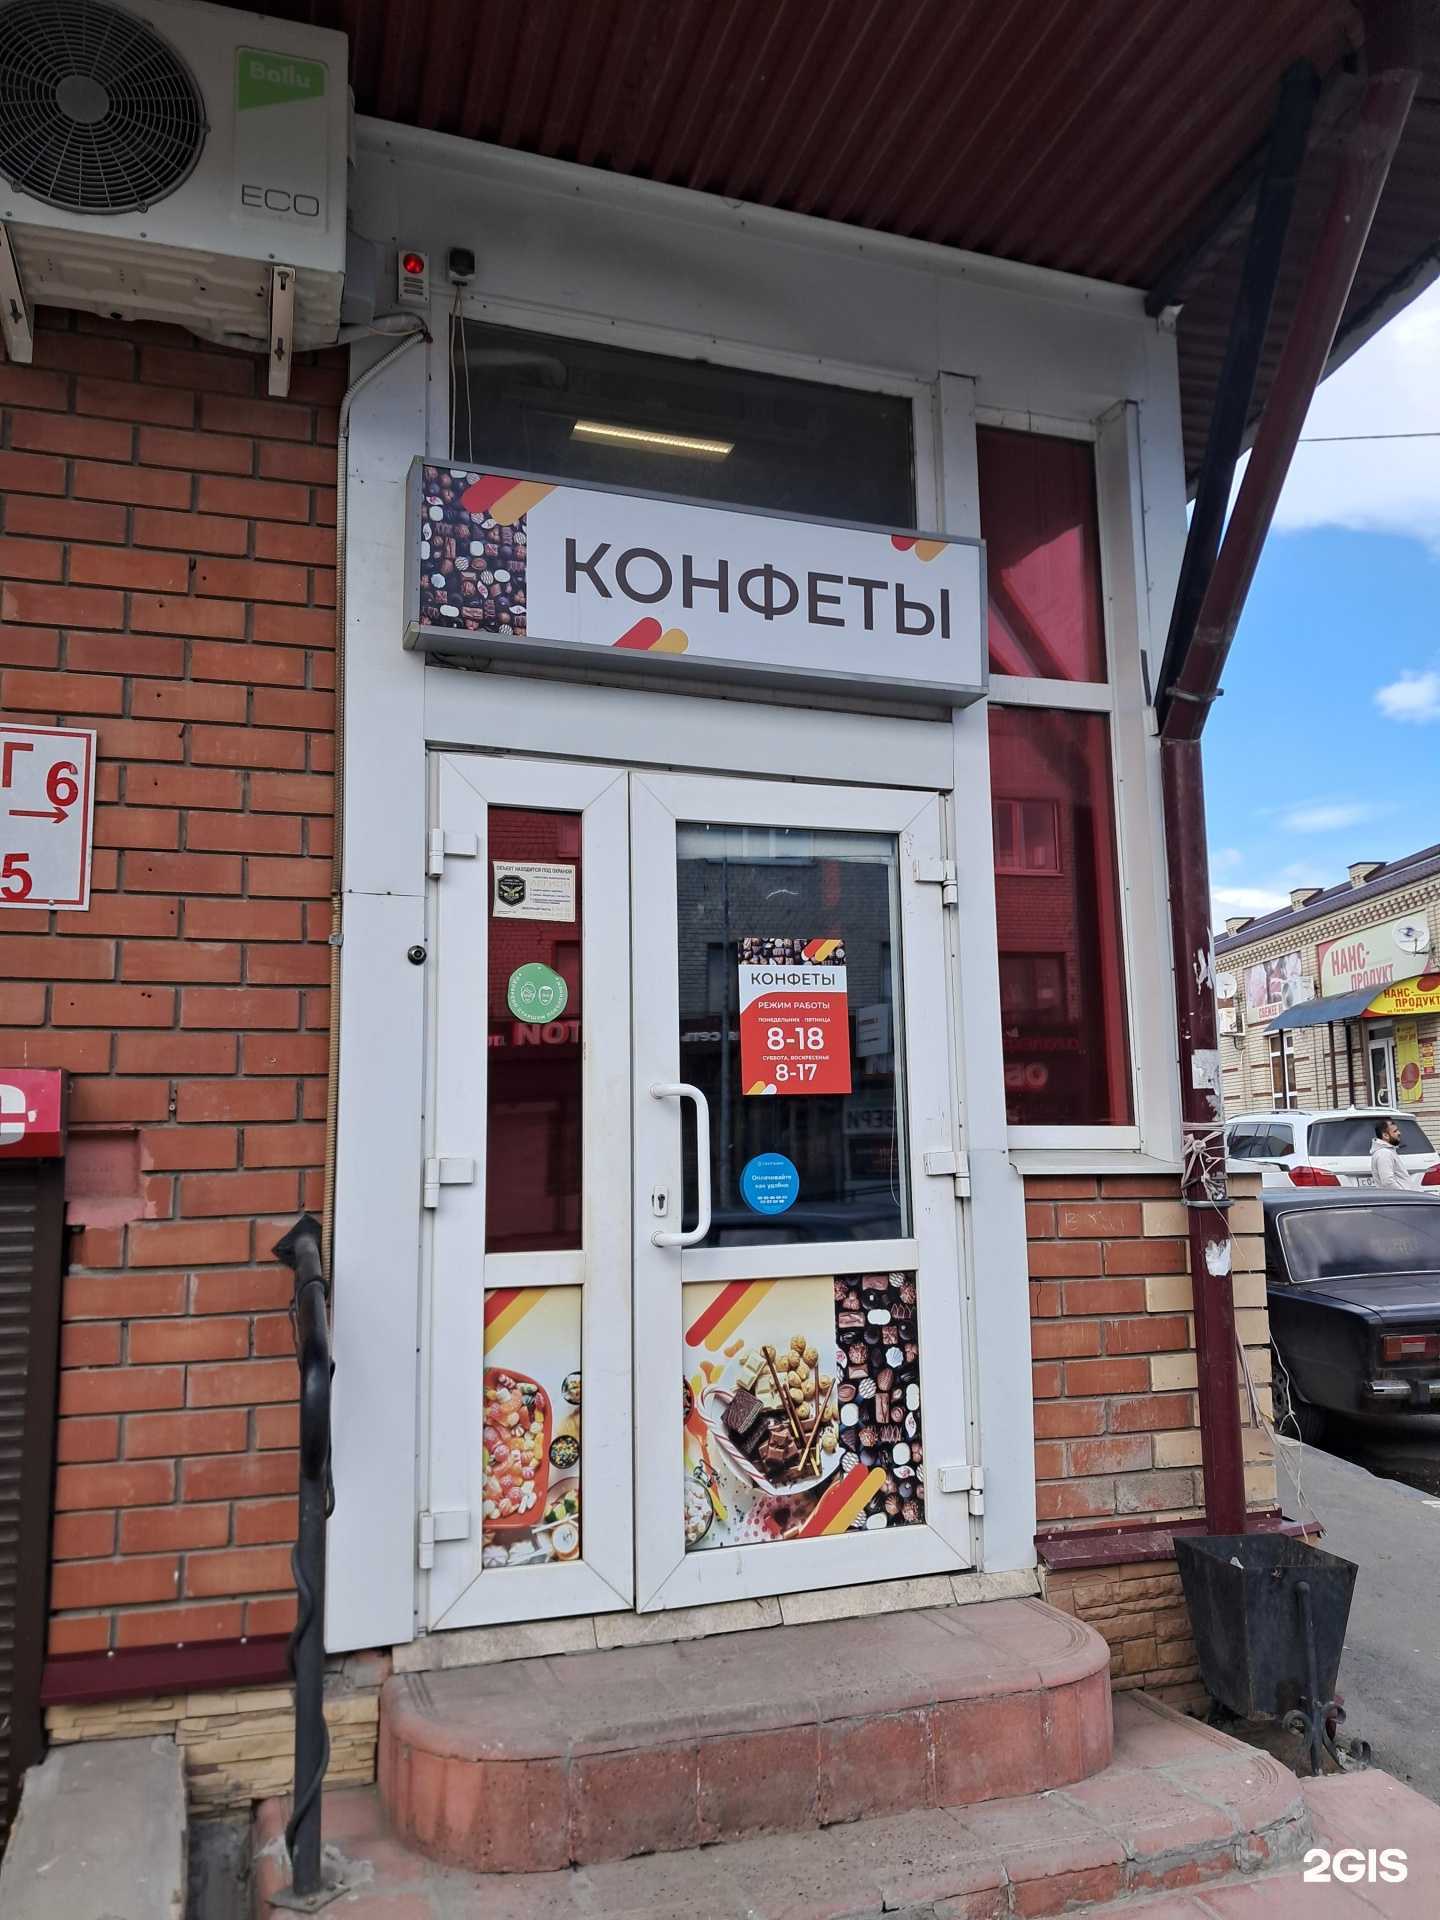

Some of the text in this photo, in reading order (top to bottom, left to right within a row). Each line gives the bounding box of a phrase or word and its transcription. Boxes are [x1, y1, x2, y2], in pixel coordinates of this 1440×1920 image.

[241, 184, 320, 217] ECO
[564, 537, 950, 639] КОНФЕТЫ
[46, 761, 79, 807] 6
[751, 973, 835, 985] КОНФЕТЫ
[758, 1001, 830, 1009] РЕЖИМ РАБОТЫ
[767, 1027, 825, 1050] 8-18
[775, 1063, 817, 1081] 8-17
